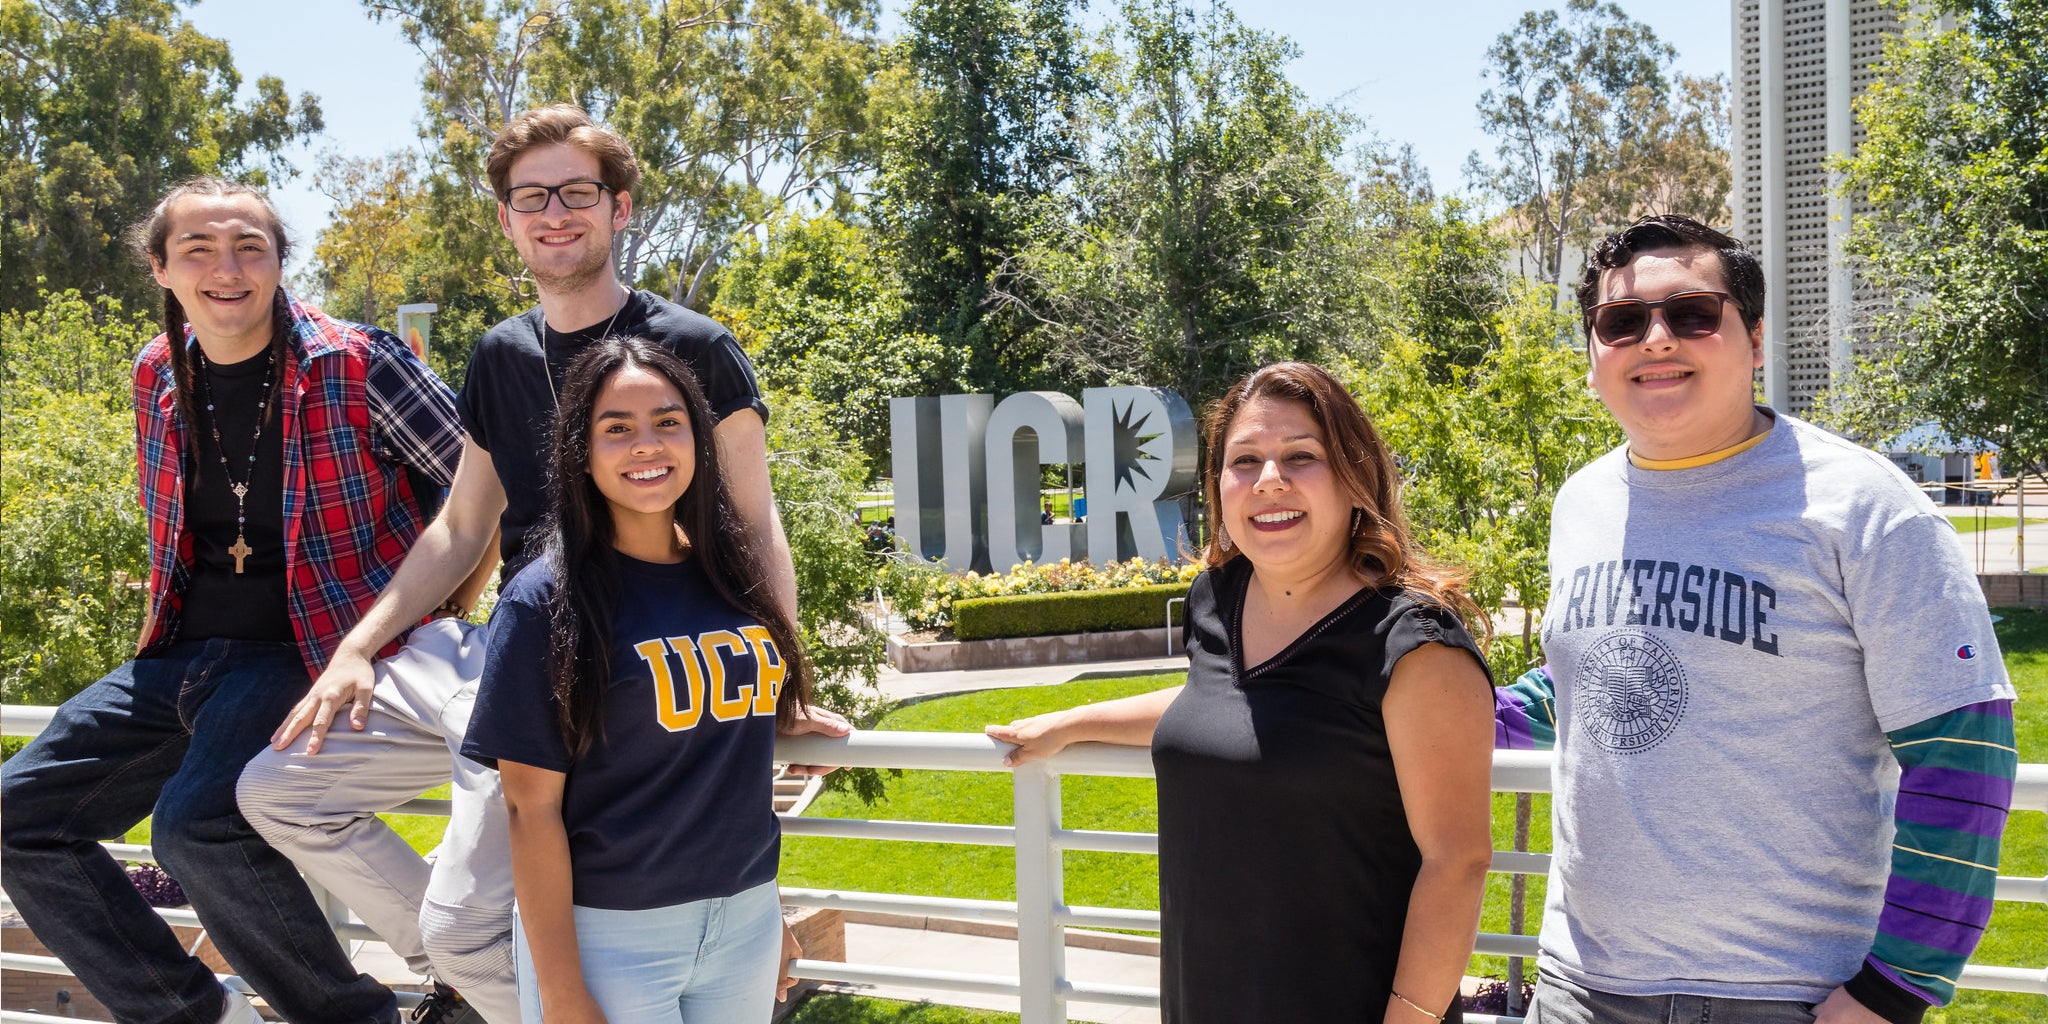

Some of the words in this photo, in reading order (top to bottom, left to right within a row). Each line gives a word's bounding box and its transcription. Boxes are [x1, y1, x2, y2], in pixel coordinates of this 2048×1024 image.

[890, 386, 1198, 573] UCR
[1563, 559, 1779, 656] RIVERSIDE
[633, 625, 787, 732] UCR
[1619, 637, 1637, 647] OF
[1643, 641, 1680, 723] CALIFORNIA
[1593, 727, 1658, 747] RIVERSIDE
